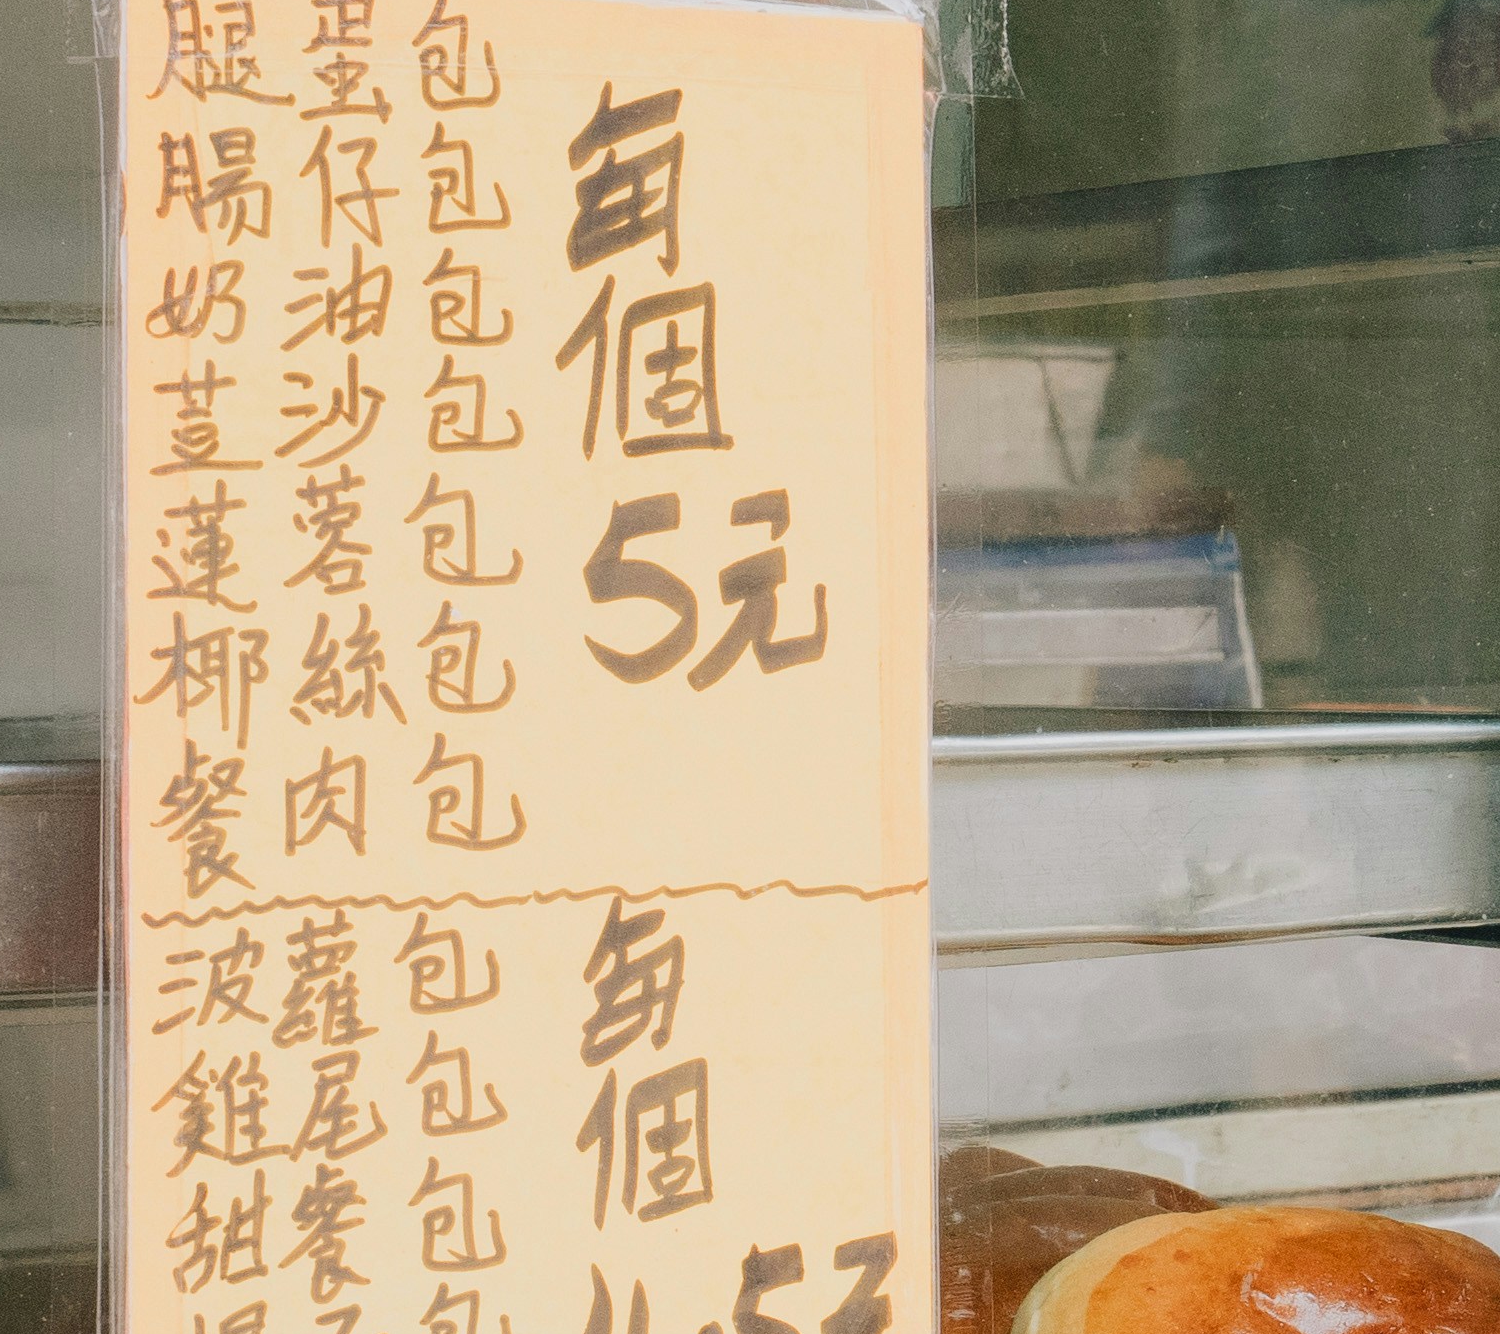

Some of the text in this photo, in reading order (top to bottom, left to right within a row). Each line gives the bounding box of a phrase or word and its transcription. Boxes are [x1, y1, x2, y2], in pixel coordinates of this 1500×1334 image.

[155, 123, 511, 248] 腸仔包
[145, 244, 513, 353] 奶油包
[146, 464, 523, 611] 蓮蓉包
[134, 600, 516, 749] 椰絲包
[150, 733, 526, 898] 餐肉包
[151, 1032, 507, 1177] 雞尾包
[165, 1157, 506, 1303] 甜餐包
